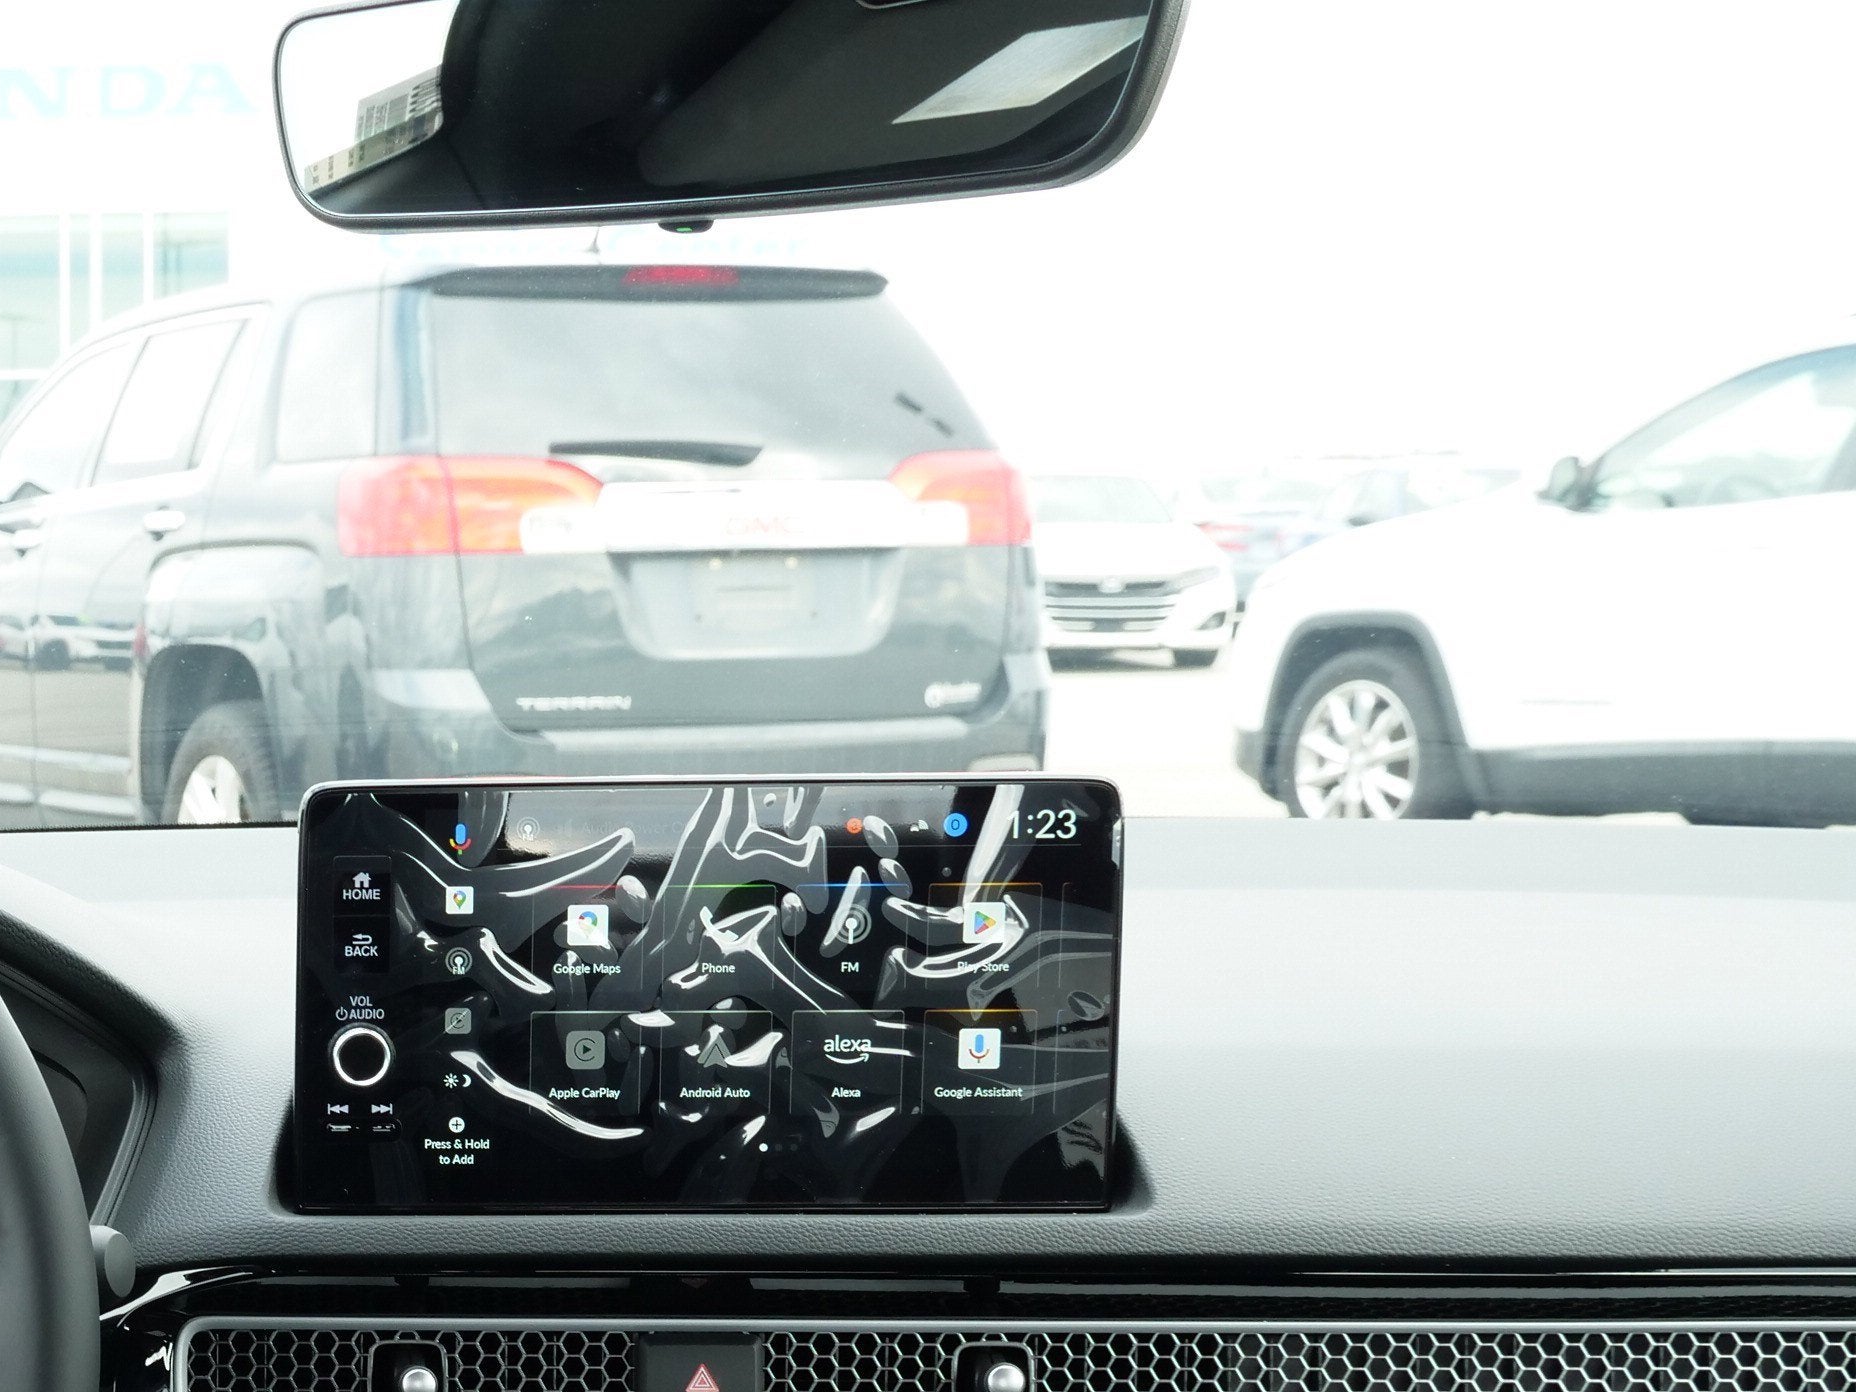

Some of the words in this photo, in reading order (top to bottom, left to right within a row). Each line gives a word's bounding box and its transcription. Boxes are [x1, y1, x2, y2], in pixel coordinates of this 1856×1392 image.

[1007, 809, 1077, 839] 1:23
[342, 888, 381, 900] HOME
[344, 945, 378, 957] BACK
[553, 963, 591, 975] Google
[593, 963, 621, 975] Maps
[701, 962, 736, 973] Phone
[841, 961, 859, 973] FM
[981, 961, 1010, 972] Store
[349, 996, 373, 1007] VOL
[349, 1008, 385, 1020] AUDIO
[823, 1035, 872, 1052] alexa
[548, 1087, 579, 1100] Apple
[581, 1087, 621, 1100] CarPlay
[679, 1087, 722, 1099] Android
[723, 1087, 751, 1099] Auto
[831, 1087, 861, 1098] Alexa
[934, 1087, 972, 1100] Google
[974, 1086, 1023, 1098] Assistant
[424, 1139, 452, 1150] Press
[453, 1139, 463, 1150] &
[464, 1139, 490, 1150] Hold
[439, 1154, 451, 1165] to
[452, 1154, 474, 1165] Add
